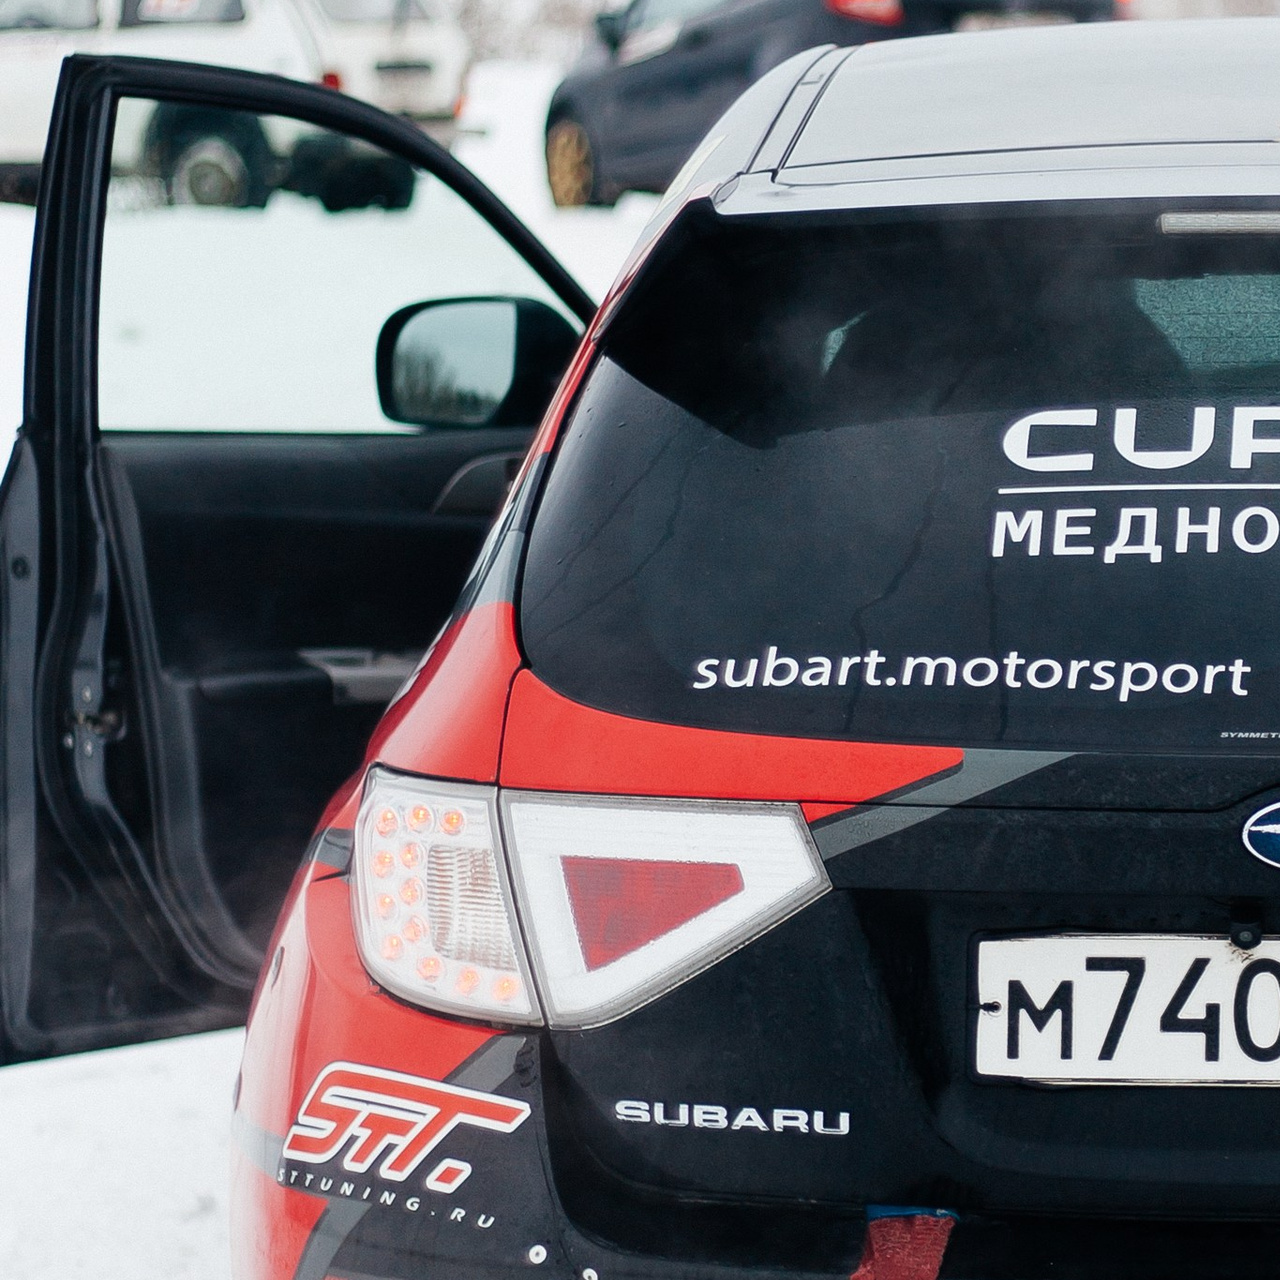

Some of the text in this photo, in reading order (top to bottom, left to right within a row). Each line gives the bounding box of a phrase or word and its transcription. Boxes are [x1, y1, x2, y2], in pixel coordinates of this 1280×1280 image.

[692, 646, 1252, 702] subart.motorsport
[614, 1099, 851, 1136] SUBARU
[276, 1166, 496, 1230] STTUNING.RU
